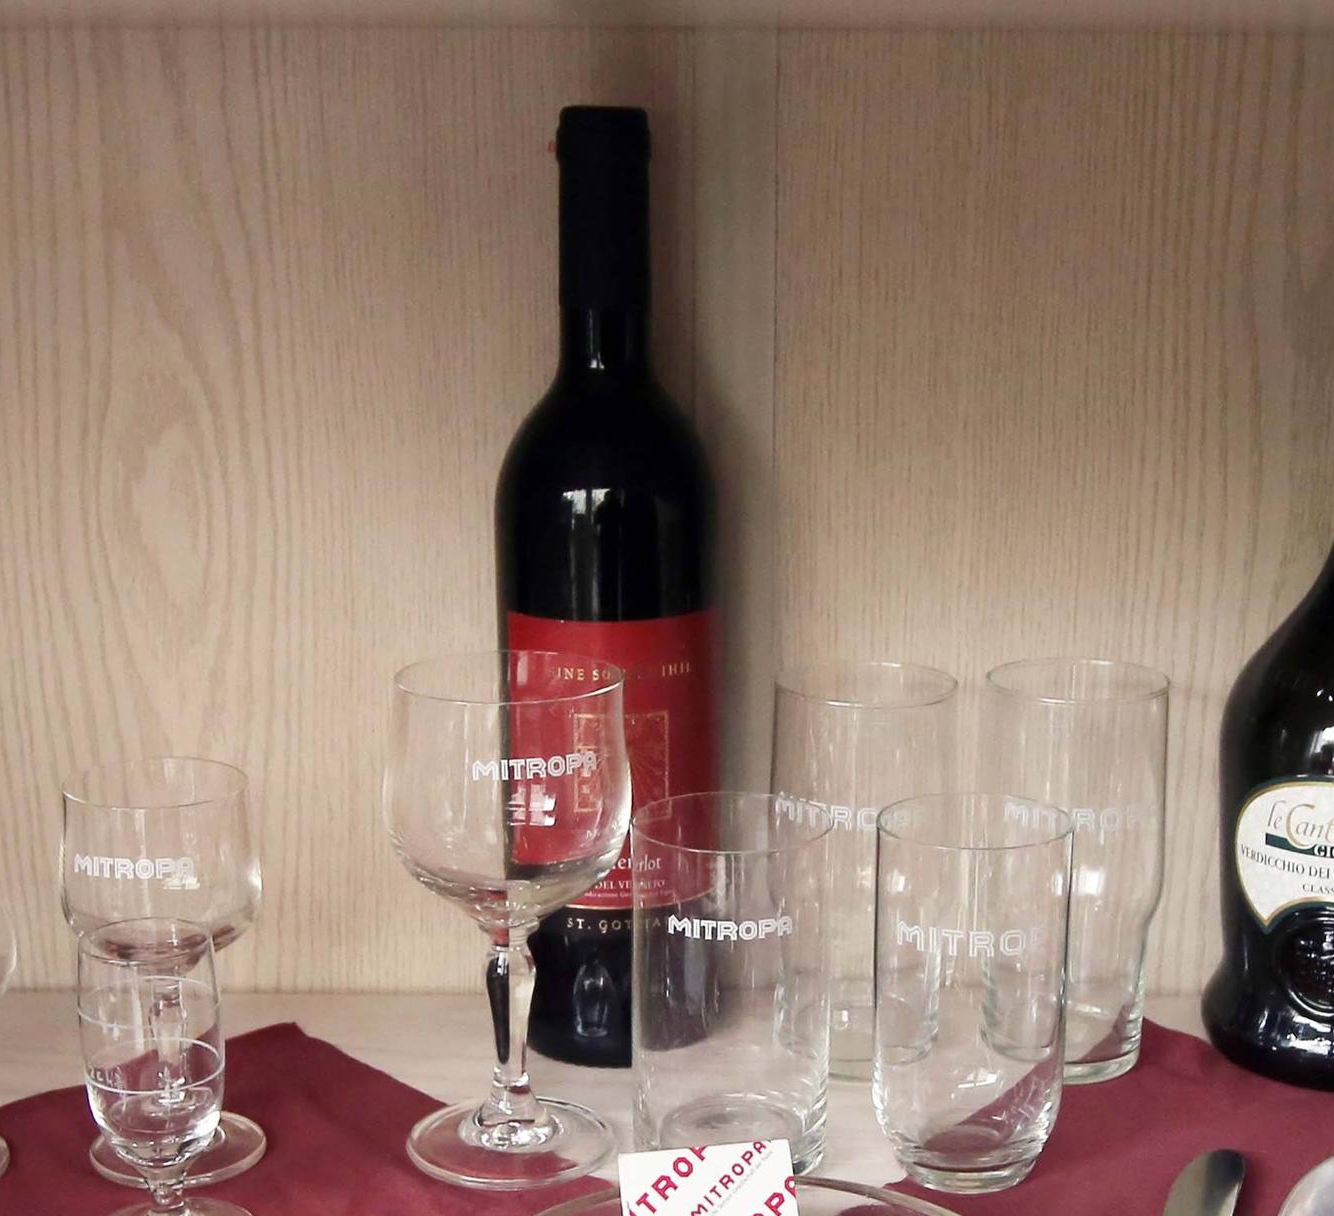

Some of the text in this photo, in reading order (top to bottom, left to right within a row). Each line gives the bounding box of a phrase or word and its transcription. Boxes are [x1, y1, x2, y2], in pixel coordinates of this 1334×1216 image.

[472, 751, 597, 781] MITROPA
[74, 854, 195, 879] MITROPA
[612, 854, 662, 871] erlot
[1240, 844, 1305, 875] VERDICCHIO
[1308, 865, 1330, 879] DEI
[668, 914, 793, 941] MITROPA
